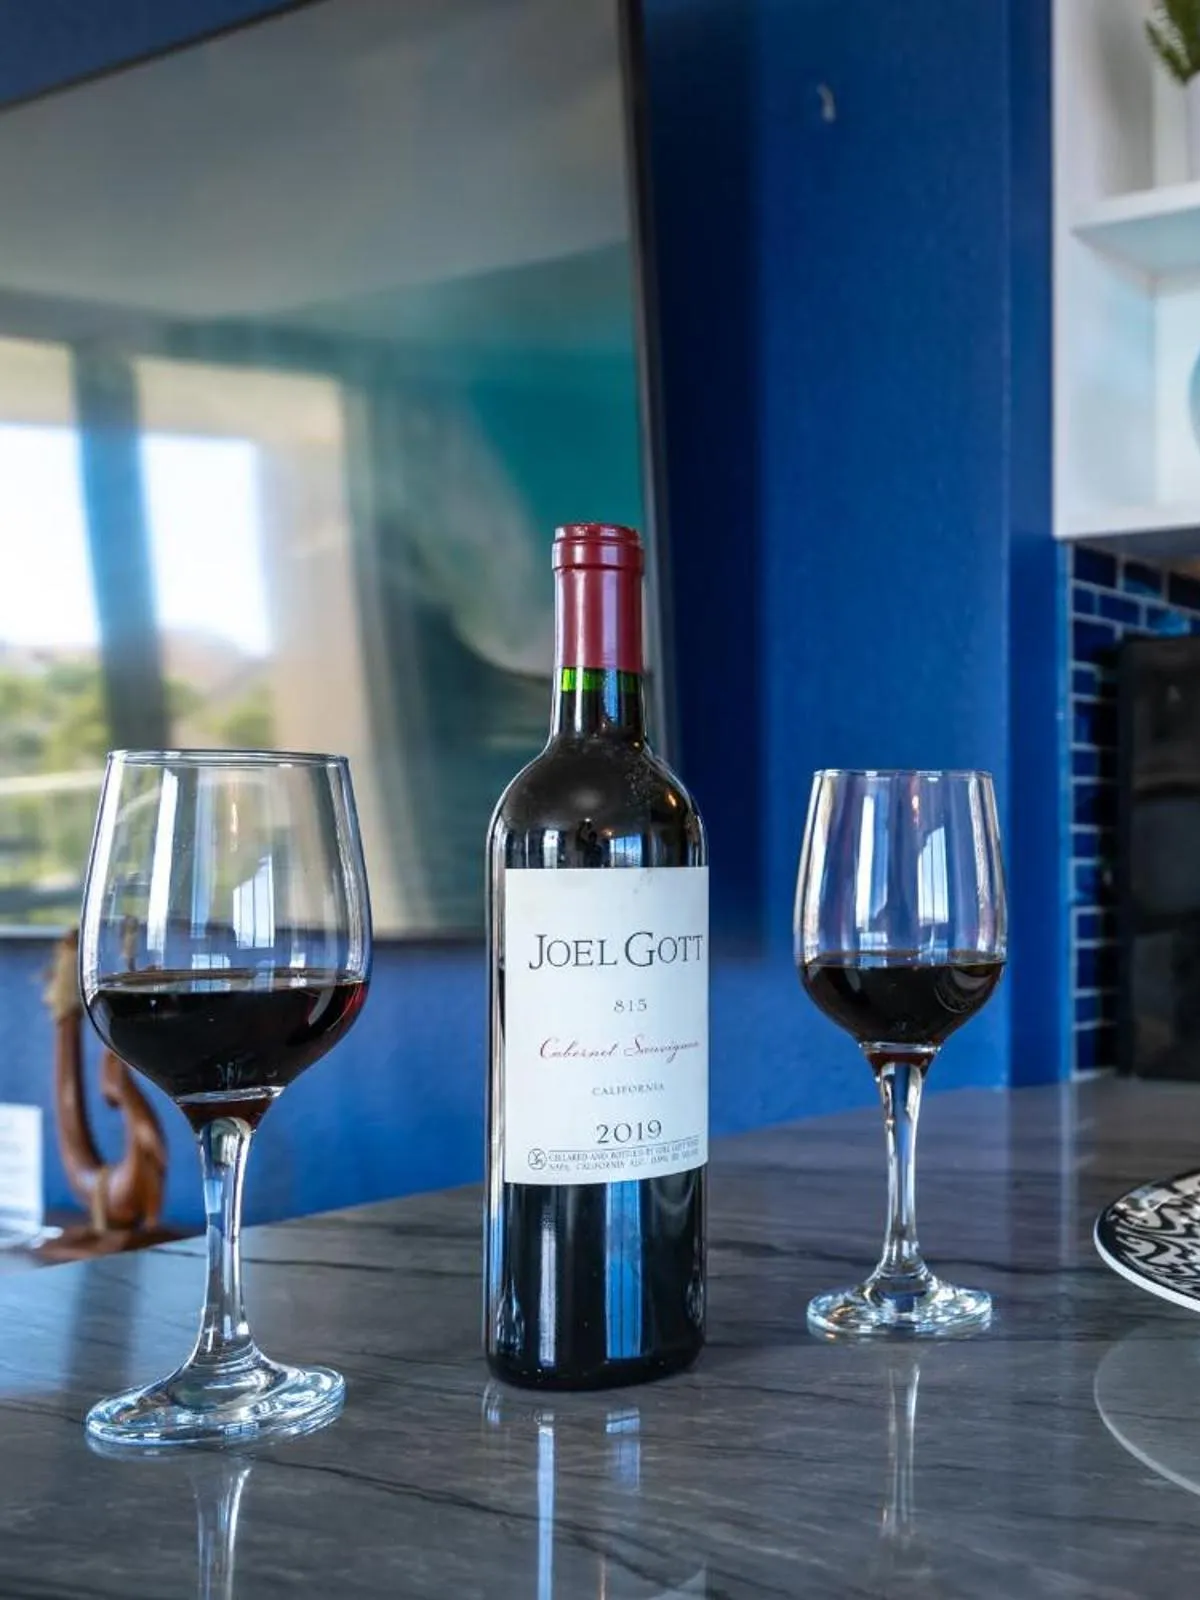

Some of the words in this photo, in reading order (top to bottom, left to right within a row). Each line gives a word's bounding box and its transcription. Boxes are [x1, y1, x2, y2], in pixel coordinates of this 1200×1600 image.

[529, 933, 618, 970] JOEL
[624, 931, 703, 968] GOTT
[613, 998, 648, 1013] 815
[540, 1037, 619, 1059] Cabernet
[592, 1081, 664, 1096] CALIFORNIA
[596, 1119, 662, 1144] 2019
